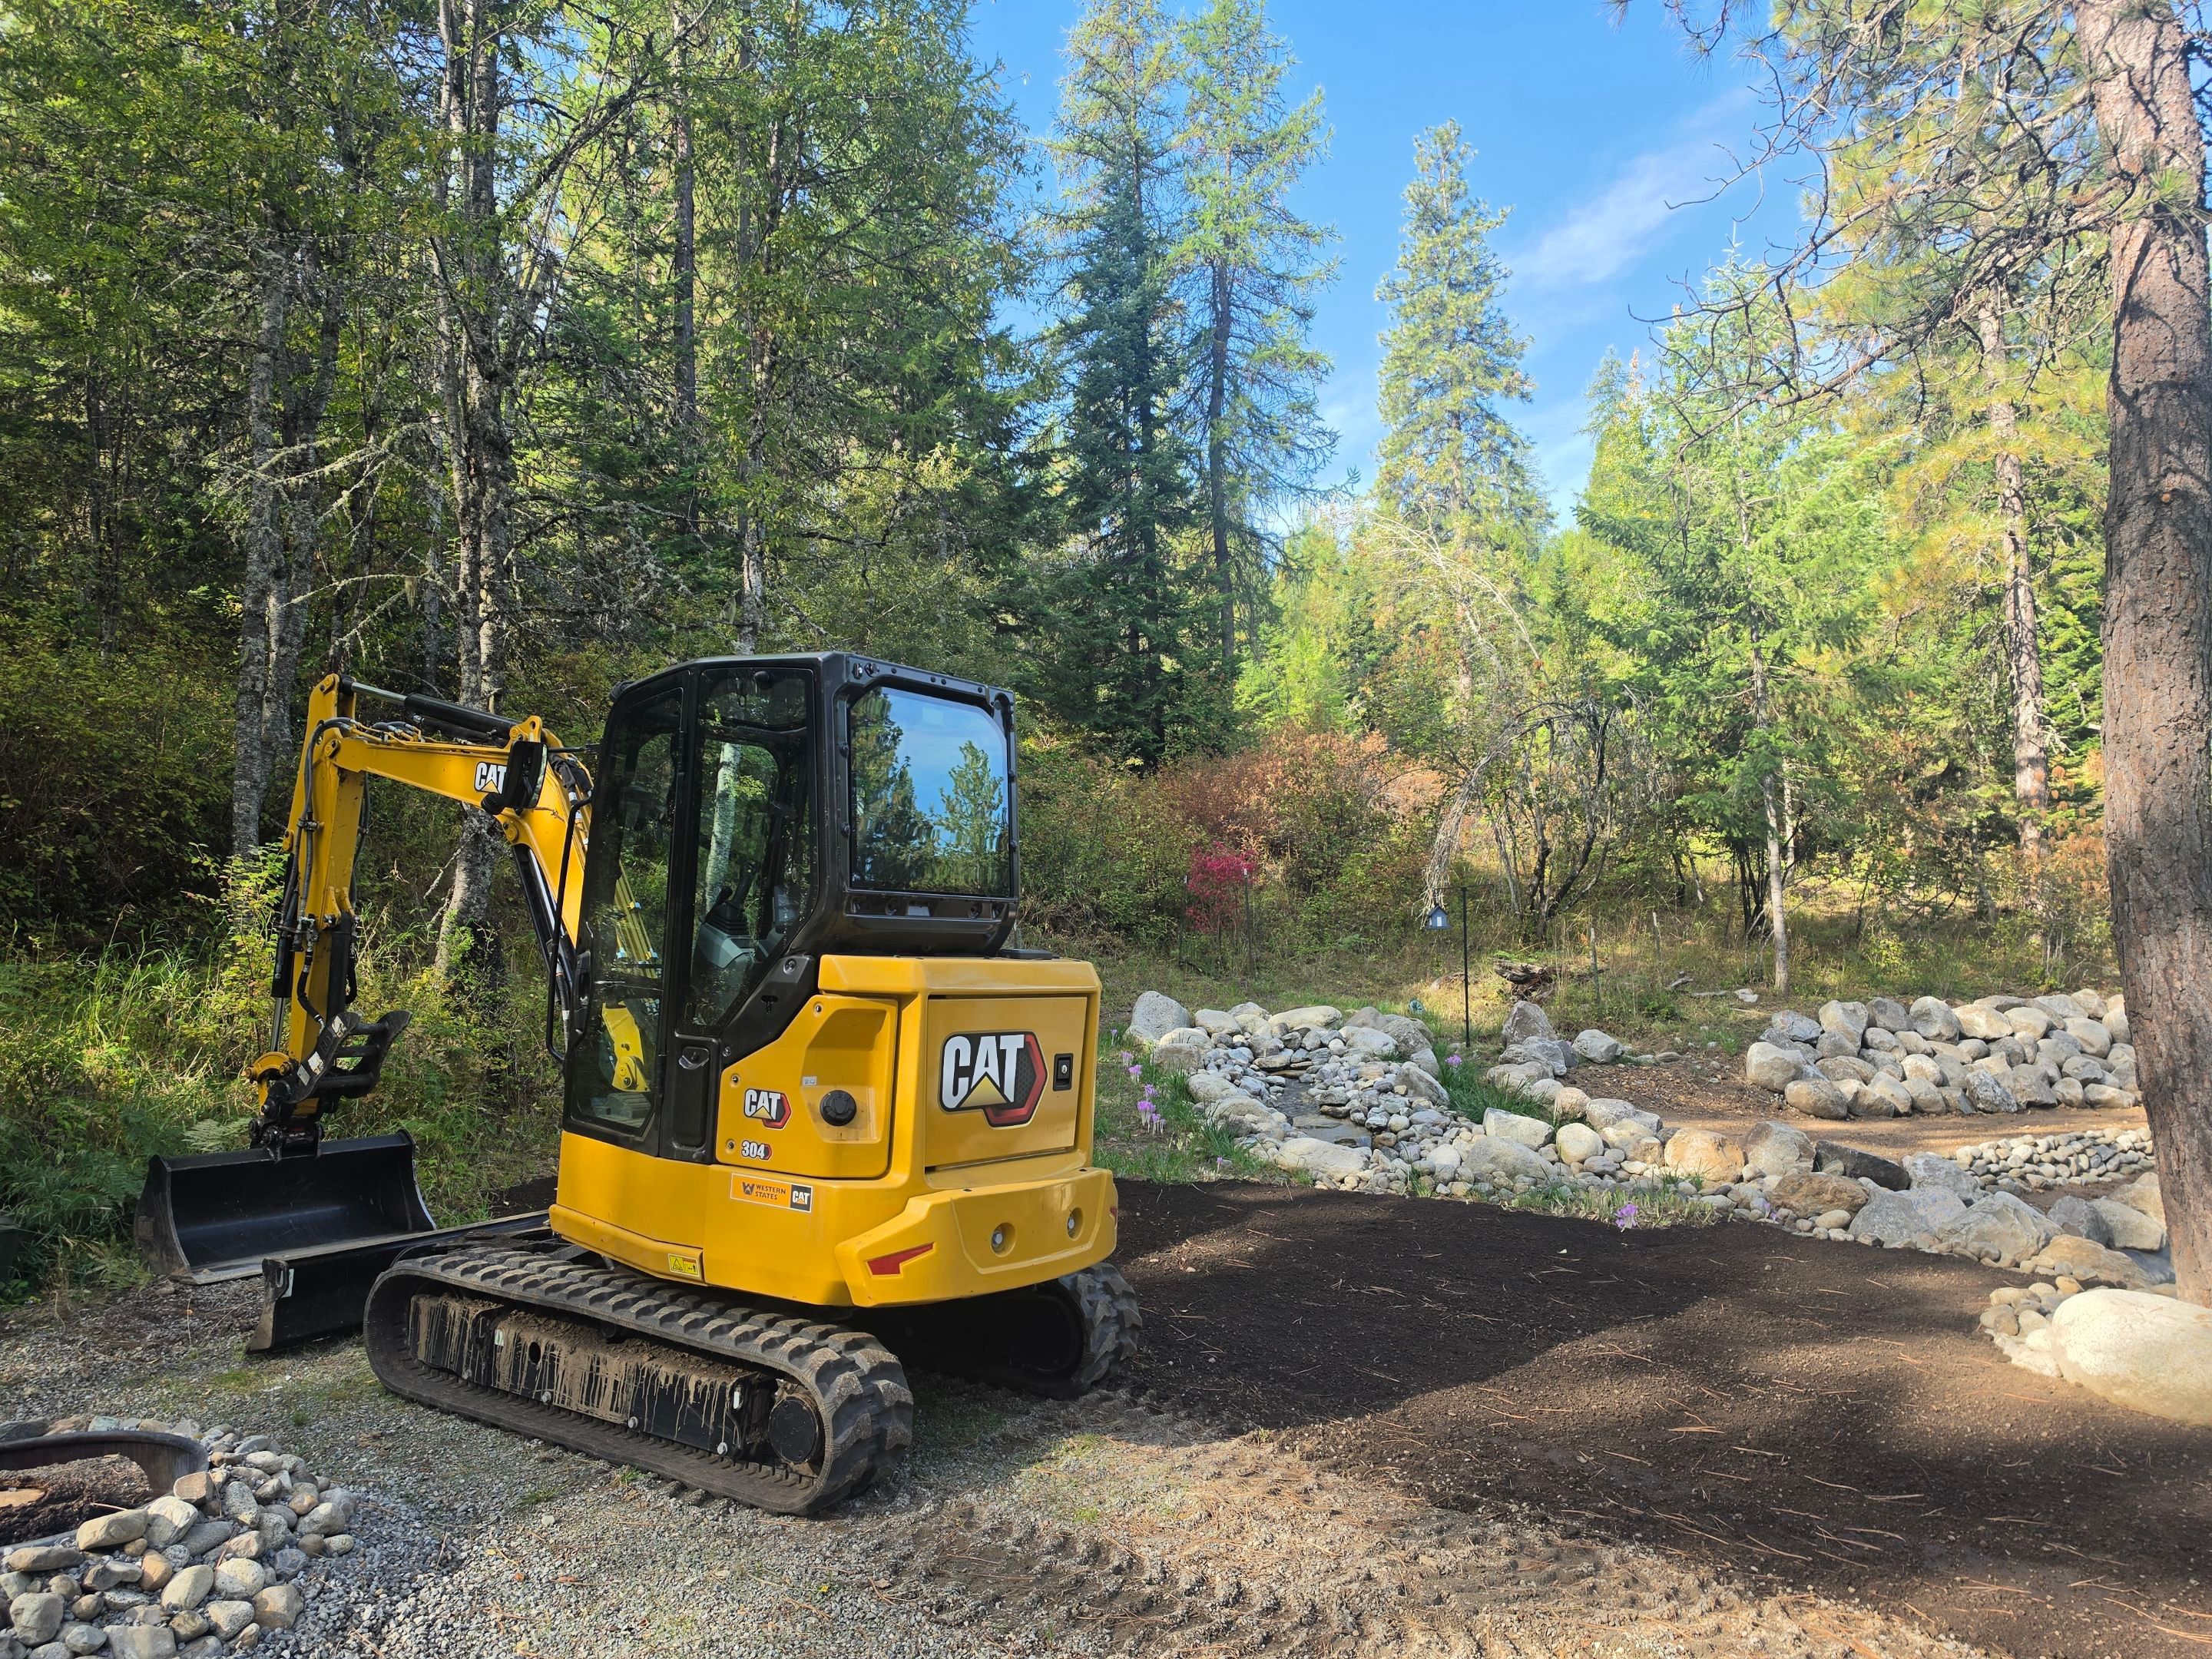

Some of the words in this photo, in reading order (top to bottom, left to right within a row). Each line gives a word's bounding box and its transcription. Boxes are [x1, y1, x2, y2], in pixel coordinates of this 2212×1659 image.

[475, 762, 507, 794] CAT
[942, 1034, 1025, 1109] CAT
[744, 1089, 781, 1120] CAT
[742, 1141, 765, 1159] 304
[755, 1191, 778, 1200] STATES
[756, 1184, 786, 1194] WESTERN
[792, 1190, 811, 1205] CAT
